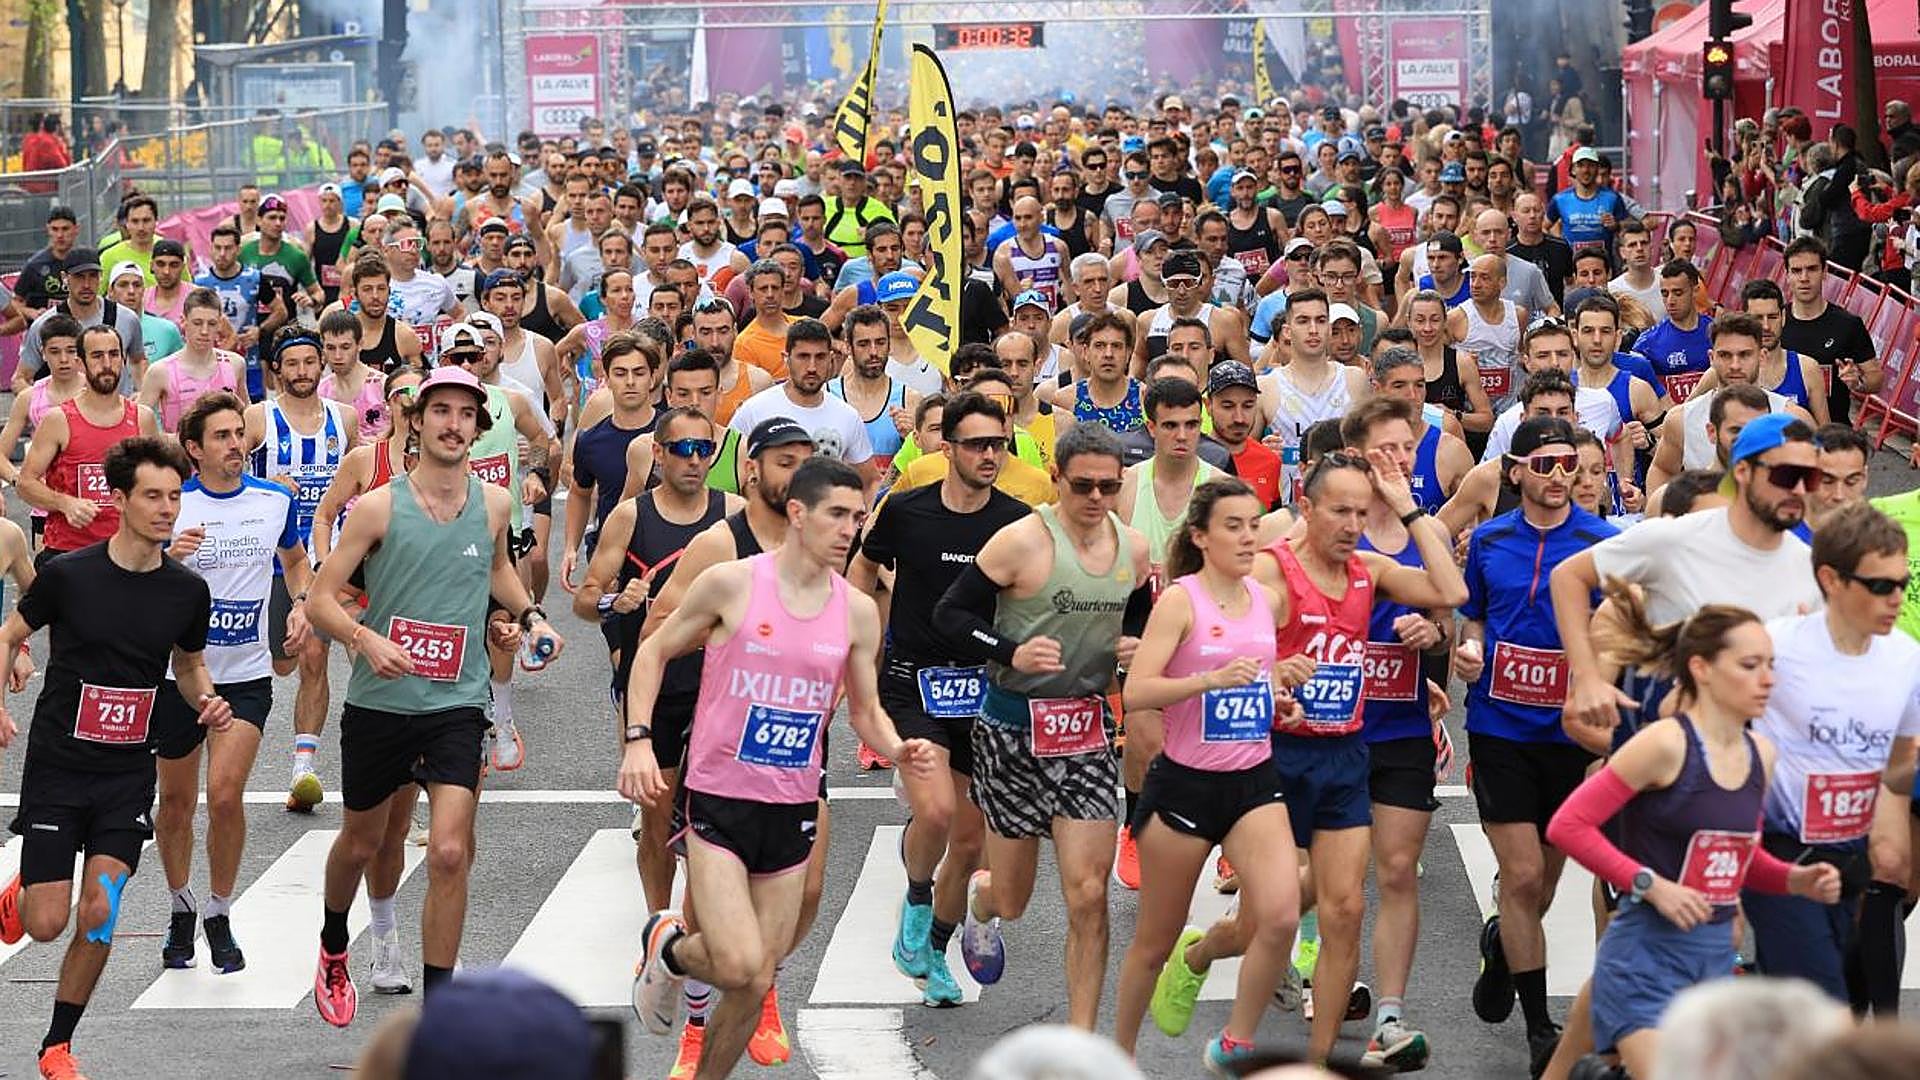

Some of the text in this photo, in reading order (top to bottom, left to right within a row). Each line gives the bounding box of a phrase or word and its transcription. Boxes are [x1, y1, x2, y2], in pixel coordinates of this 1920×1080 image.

[959, 26, 1032, 47] 0:00:32
[219, 535, 260, 548] media
[941, 552, 975, 564] BANDIT
[209, 610, 255, 630] 6020
[400, 634, 454, 661] 2453
[1503, 661, 1557, 686] 4101
[931, 678, 981, 700] 5478
[97, 702, 137, 725] 731
[1214, 696, 1267, 720] 6741
[1044, 710, 1095, 736] 3967
[754, 722, 811, 749] 6782
[1819, 786, 1877, 817] 1827
